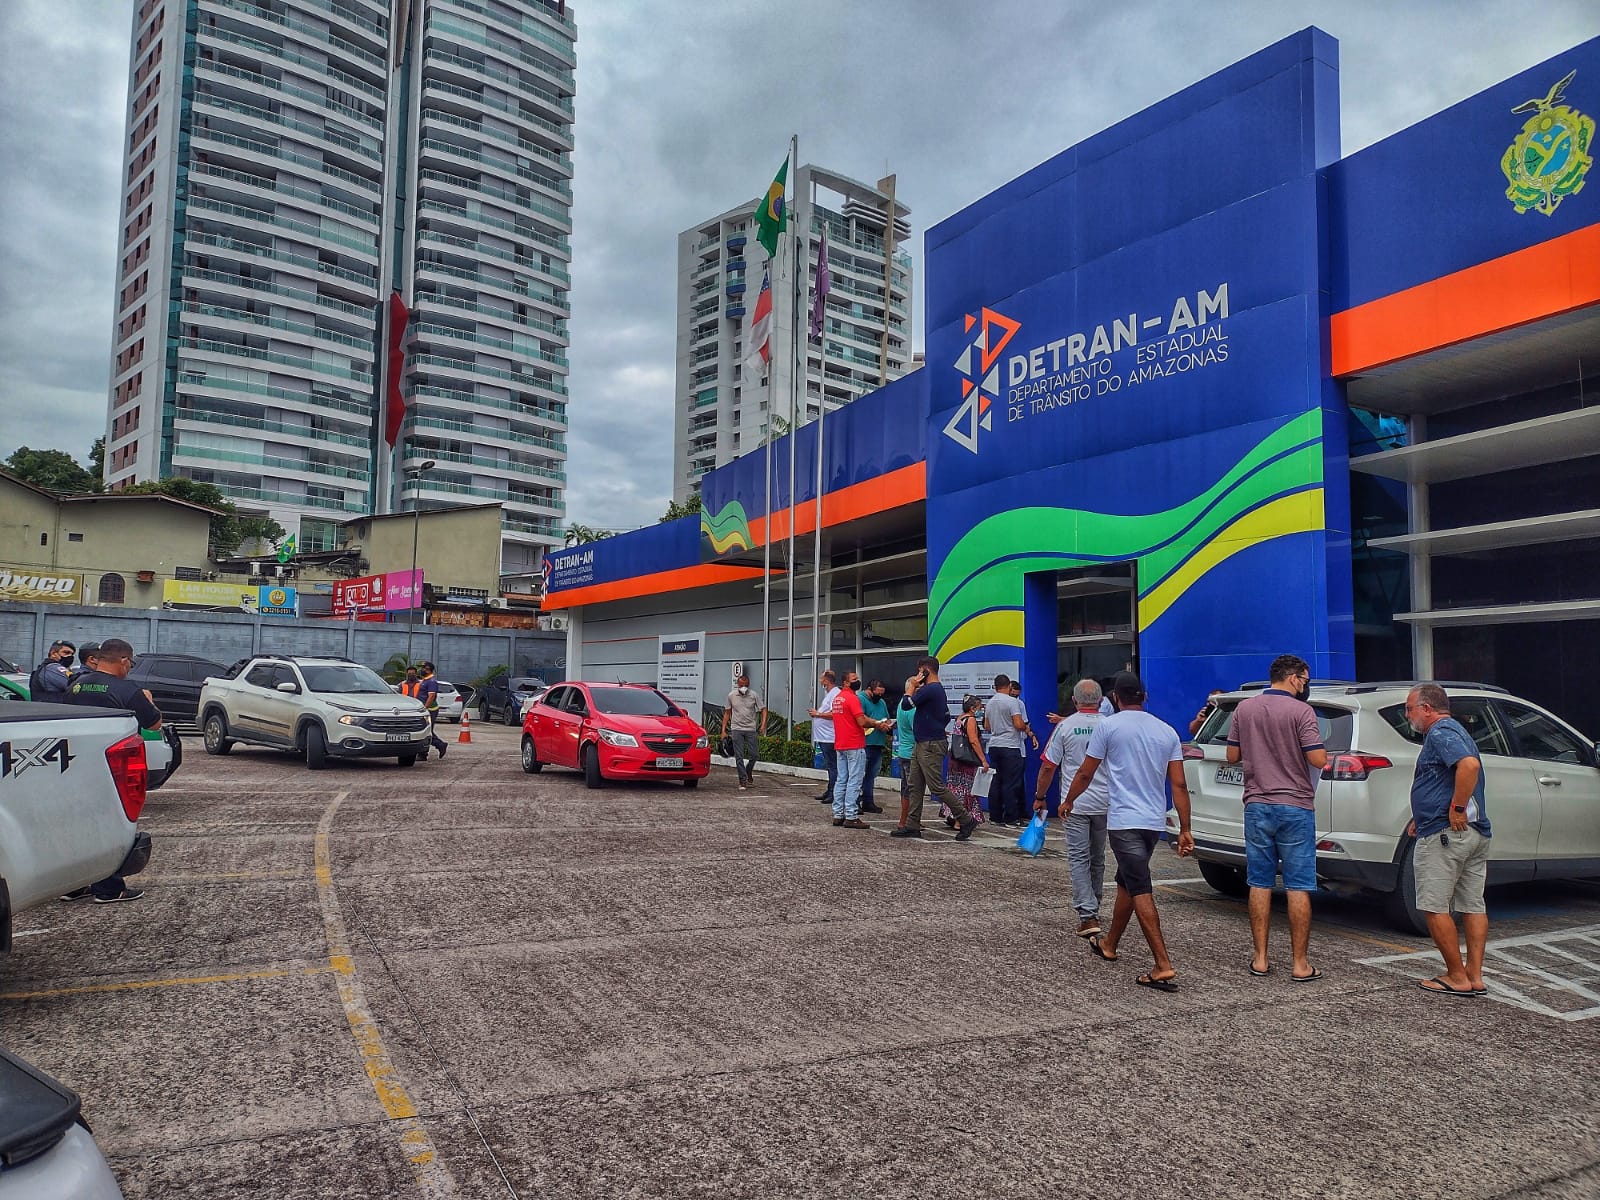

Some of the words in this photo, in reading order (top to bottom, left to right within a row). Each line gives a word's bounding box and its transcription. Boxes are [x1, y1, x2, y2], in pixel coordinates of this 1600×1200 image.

[1008, 282, 1229, 387] DETRAN-AM
[1008, 358, 1112, 404] DEPARTAMENTO
[1137, 324, 1229, 364] ESTADUAL
[1008, 404, 1024, 422] DE
[1030, 385, 1091, 415] TRÂNSITO
[1098, 377, 1121, 395] DO
[1127, 344, 1229, 386] AMAZONAS
[555, 550, 593, 570] DETRAN-AM
[1074, 726, 1093, 735] Uni
